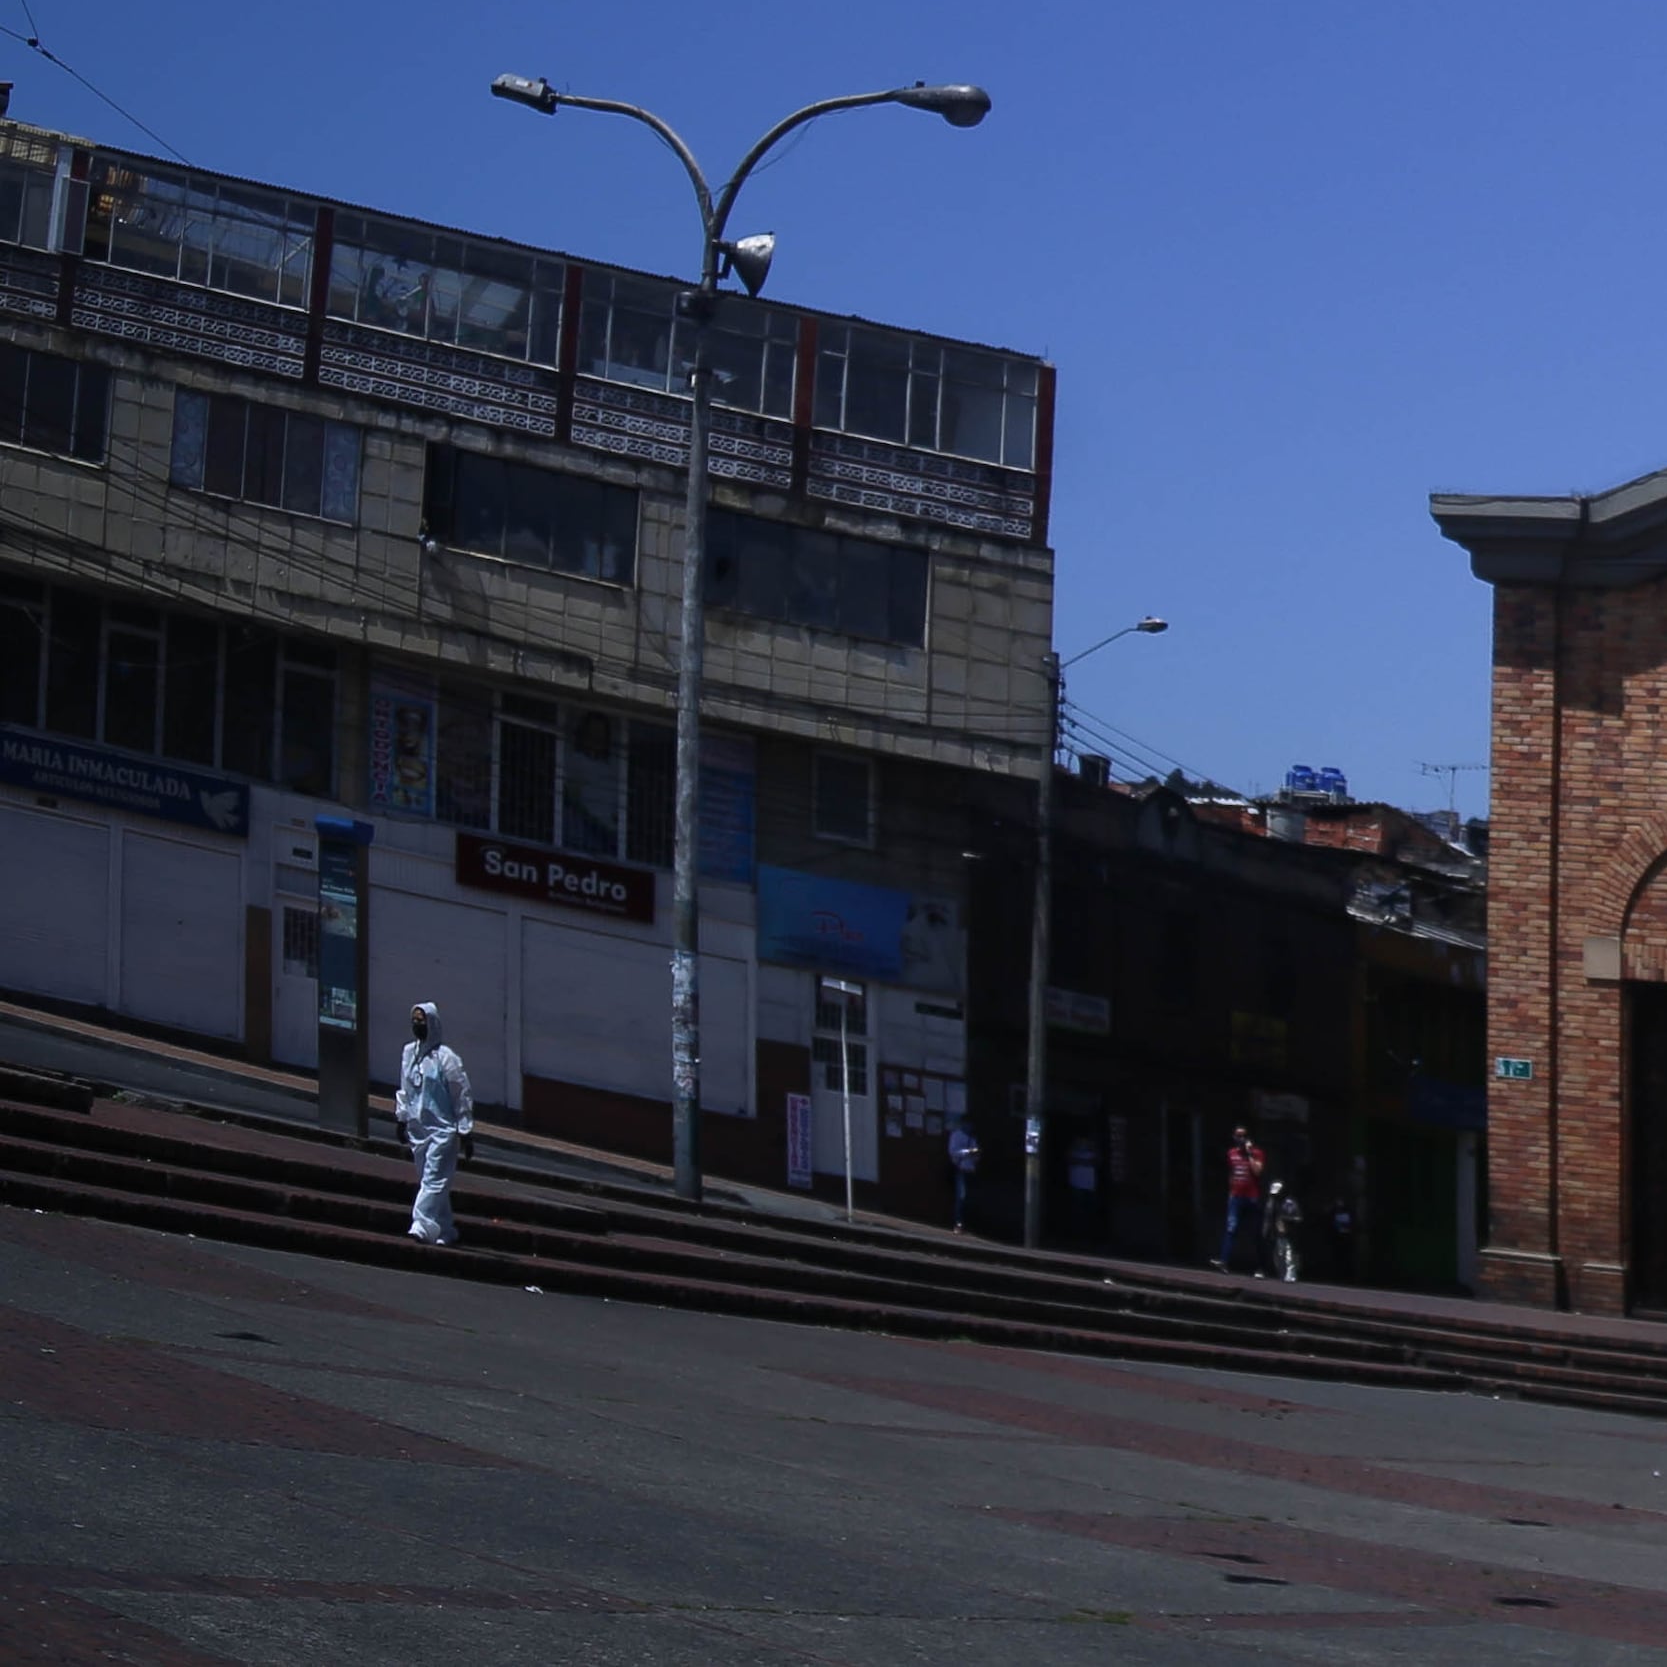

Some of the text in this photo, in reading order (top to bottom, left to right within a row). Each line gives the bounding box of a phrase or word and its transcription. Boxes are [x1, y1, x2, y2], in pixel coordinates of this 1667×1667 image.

[68, 753, 192, 801] INMACULADA
[483, 850, 539, 883] San
[547, 862, 627, 901] Pedro
